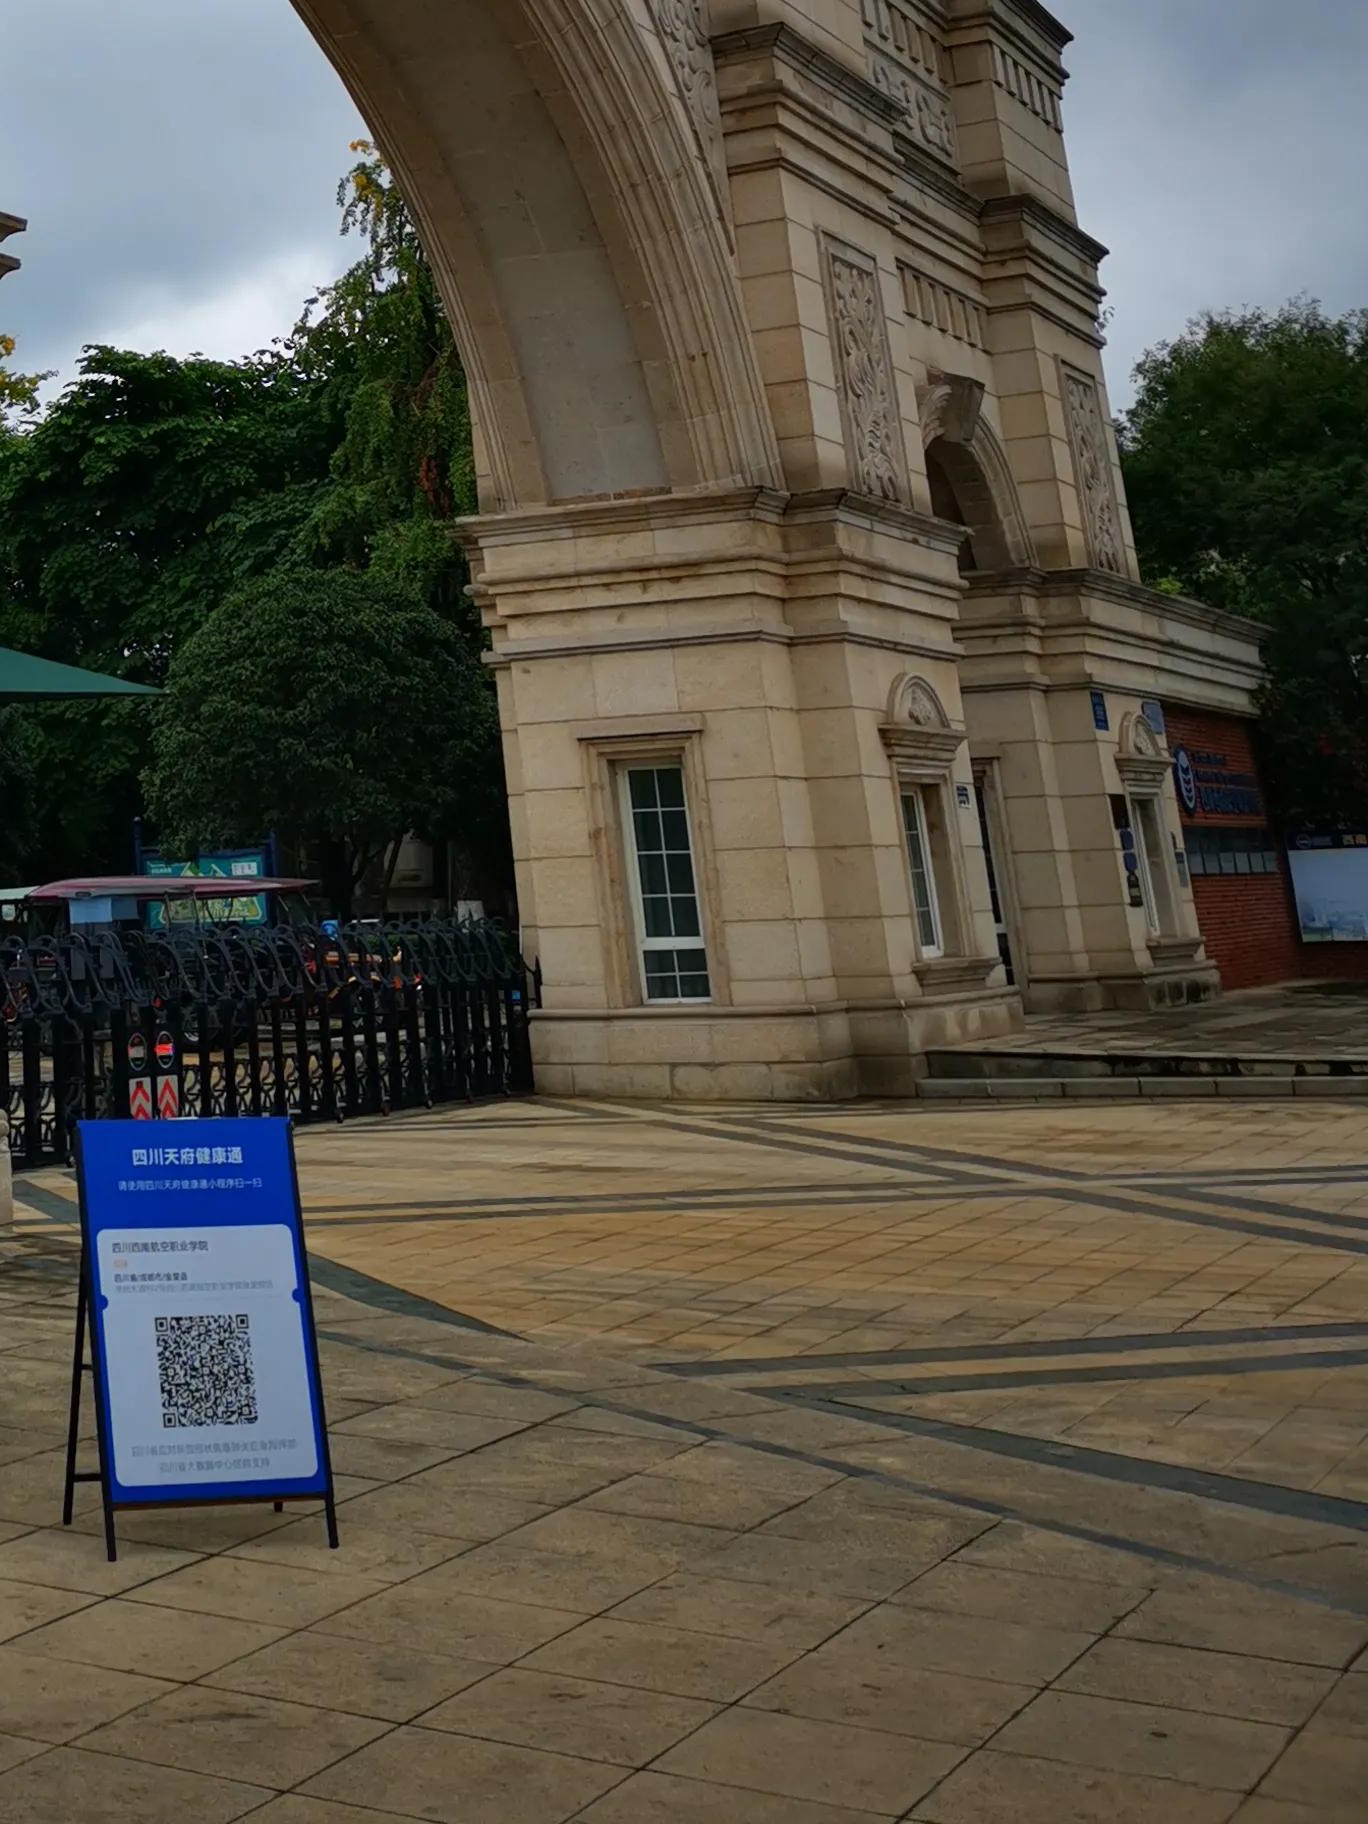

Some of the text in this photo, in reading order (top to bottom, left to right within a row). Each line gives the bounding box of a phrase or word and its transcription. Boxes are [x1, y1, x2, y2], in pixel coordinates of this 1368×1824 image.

[132, 1147, 243, 1166] 四川天府健康通
